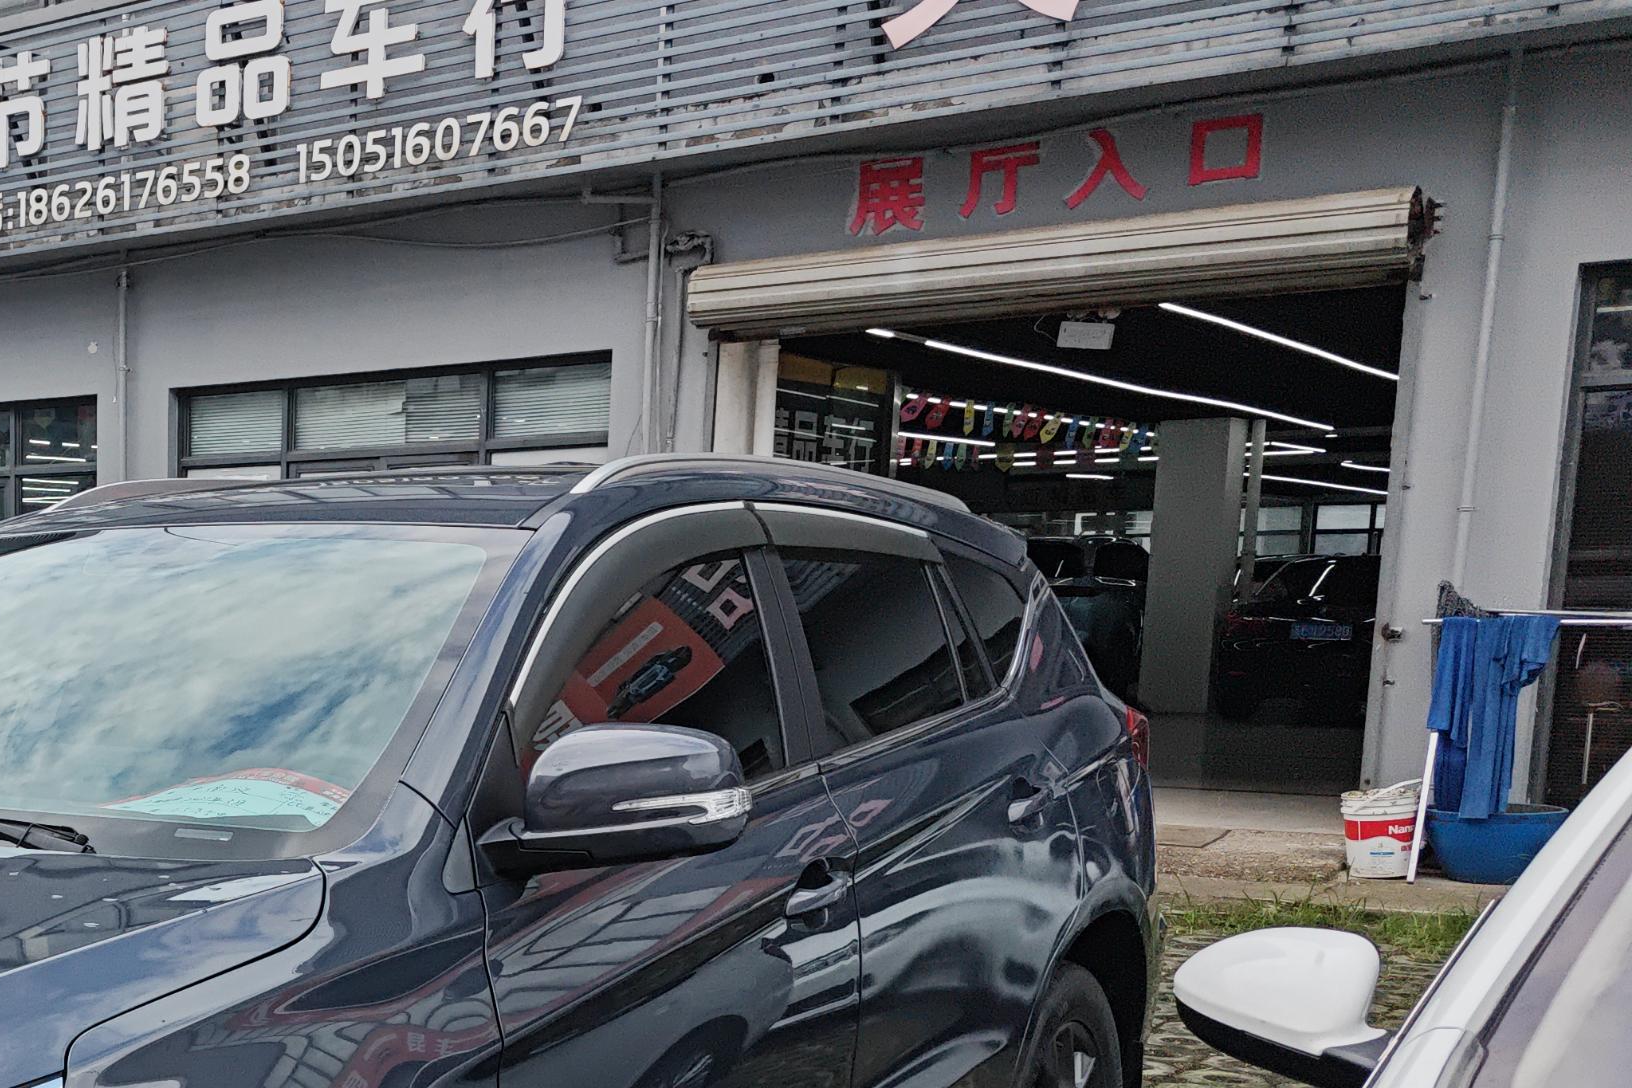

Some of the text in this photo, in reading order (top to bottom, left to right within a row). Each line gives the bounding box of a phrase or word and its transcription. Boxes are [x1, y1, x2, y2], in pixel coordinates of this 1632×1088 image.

[296, 95, 583, 184] 15051607667
[848, 112, 1264, 237] 展厅入口
